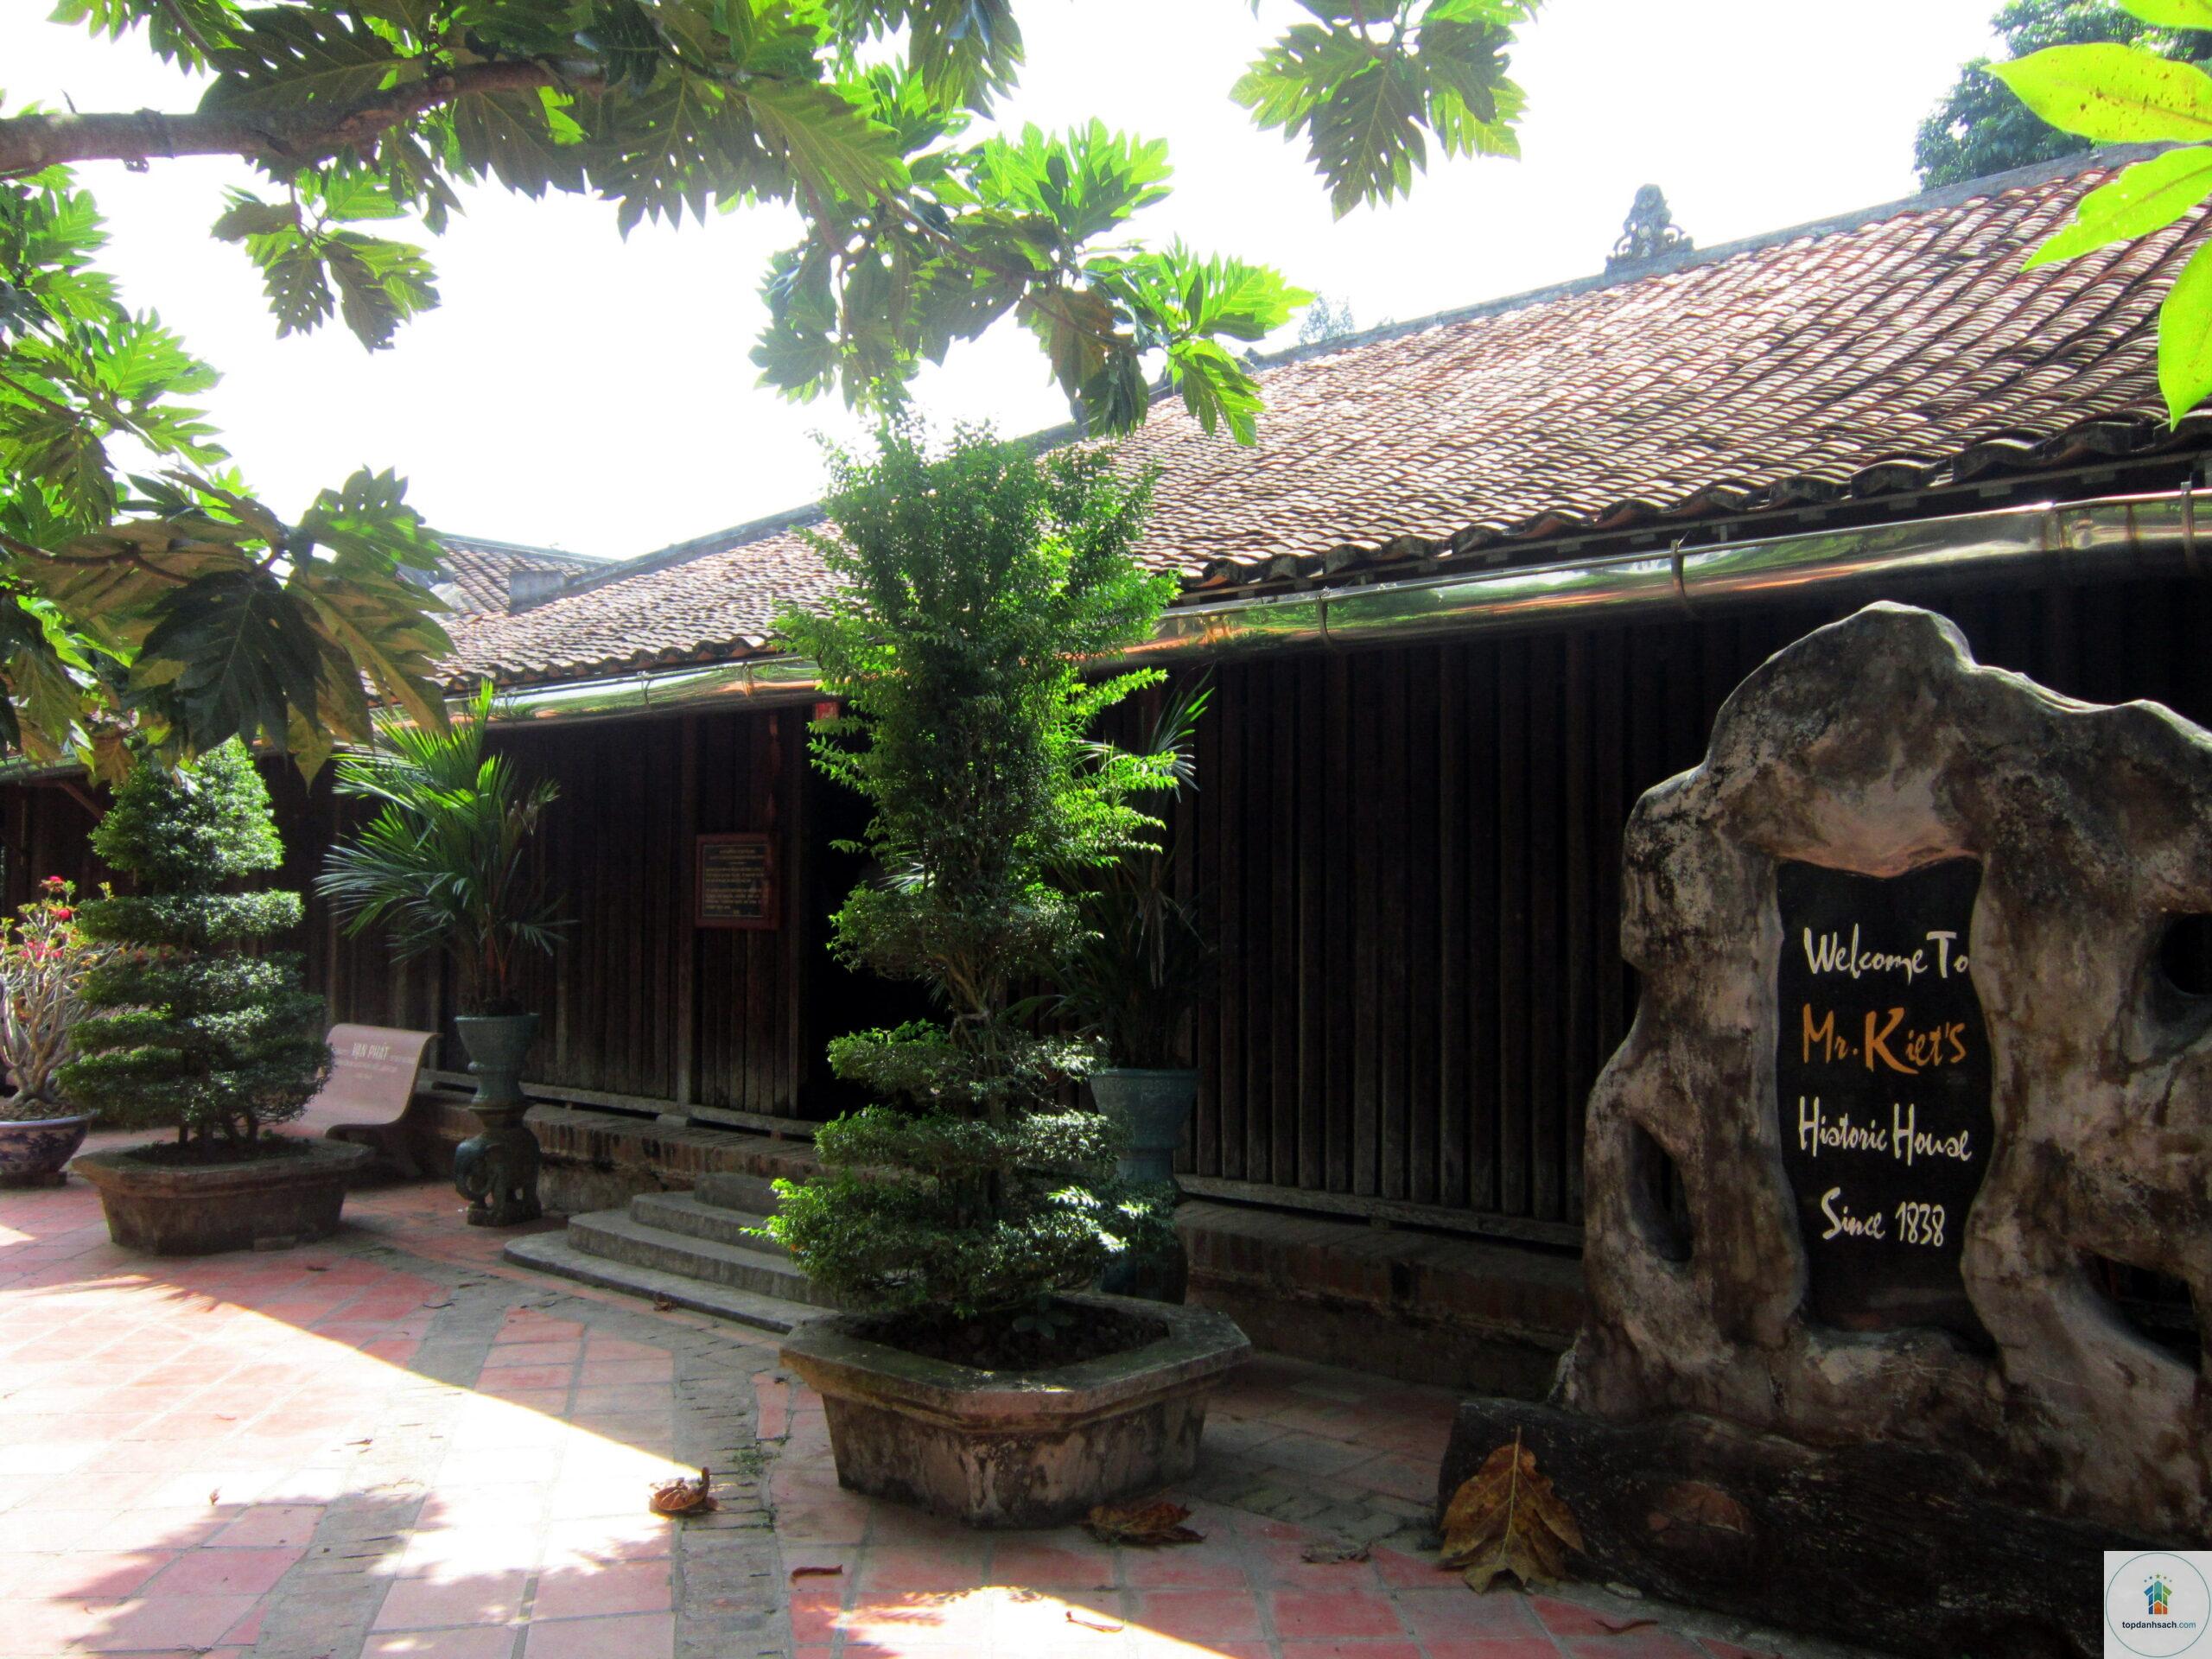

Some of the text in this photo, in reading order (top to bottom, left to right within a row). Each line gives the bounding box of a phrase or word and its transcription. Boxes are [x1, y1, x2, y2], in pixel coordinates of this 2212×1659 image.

[1803, 923, 1969, 985] Welcome To
[1802, 1003, 1859, 1065] Mr.
[1799, 1096, 1972, 1166] Historic House
[1821, 1186, 1945, 1247] Since 1838
